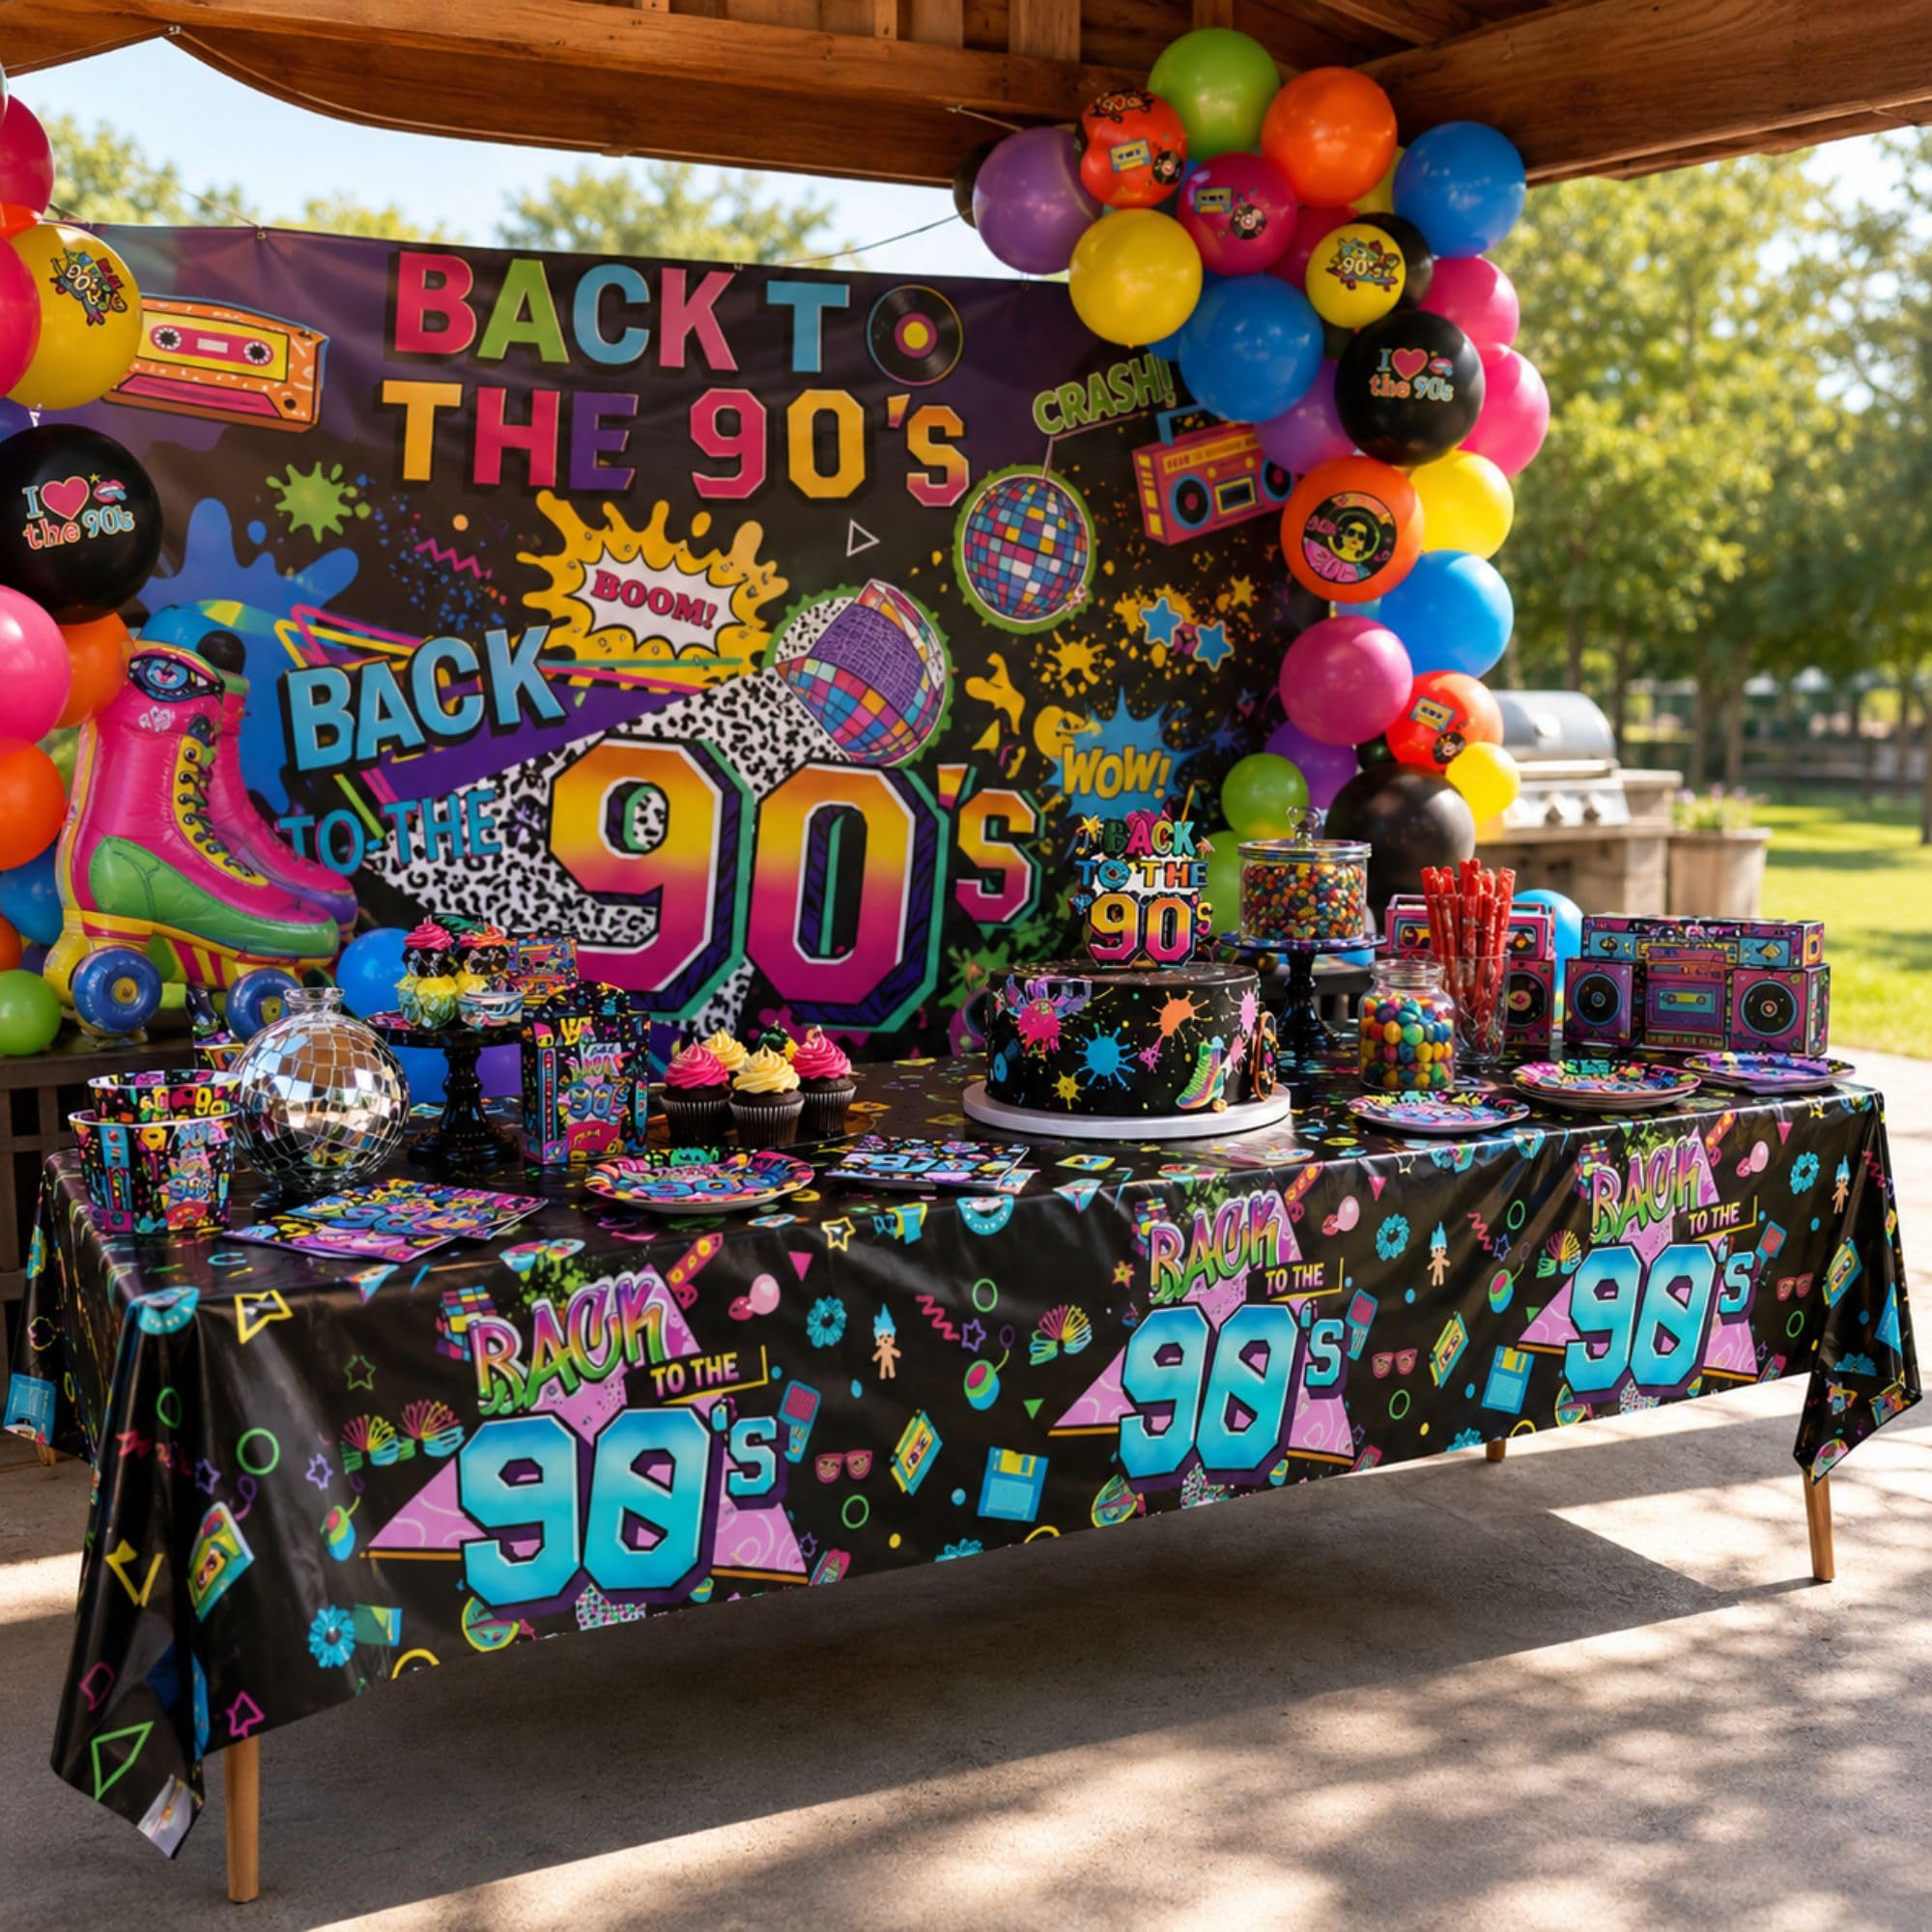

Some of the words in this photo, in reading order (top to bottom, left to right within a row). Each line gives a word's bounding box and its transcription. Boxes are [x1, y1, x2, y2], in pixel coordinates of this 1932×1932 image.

[395, 251, 740, 374] BACK
[1376, 348, 1392, 373] I
[1032, 353, 1177, 435] CRASH!
[382, 379, 639, 492] THE
[21, 485, 44, 521] I
[22, 517, 81, 551] the
[589, 568, 719, 631] BOOM!
[285, 626, 568, 772] BACK
[1062, 744, 1173, 800] WOW!
[1101, 817, 1197, 858] BACK
[1074, 859, 1131, 890] TO
[1139, 860, 1208, 889] THE
[1688, 1211, 1709, 1236] TO
[1711, 1202, 1742, 1229] THE
[1264, 1269, 1289, 1295] TO
[1292, 1262, 1325, 1290] THE
[649, 1362, 686, 1398] TO
[689, 1351, 740, 1388] THE
